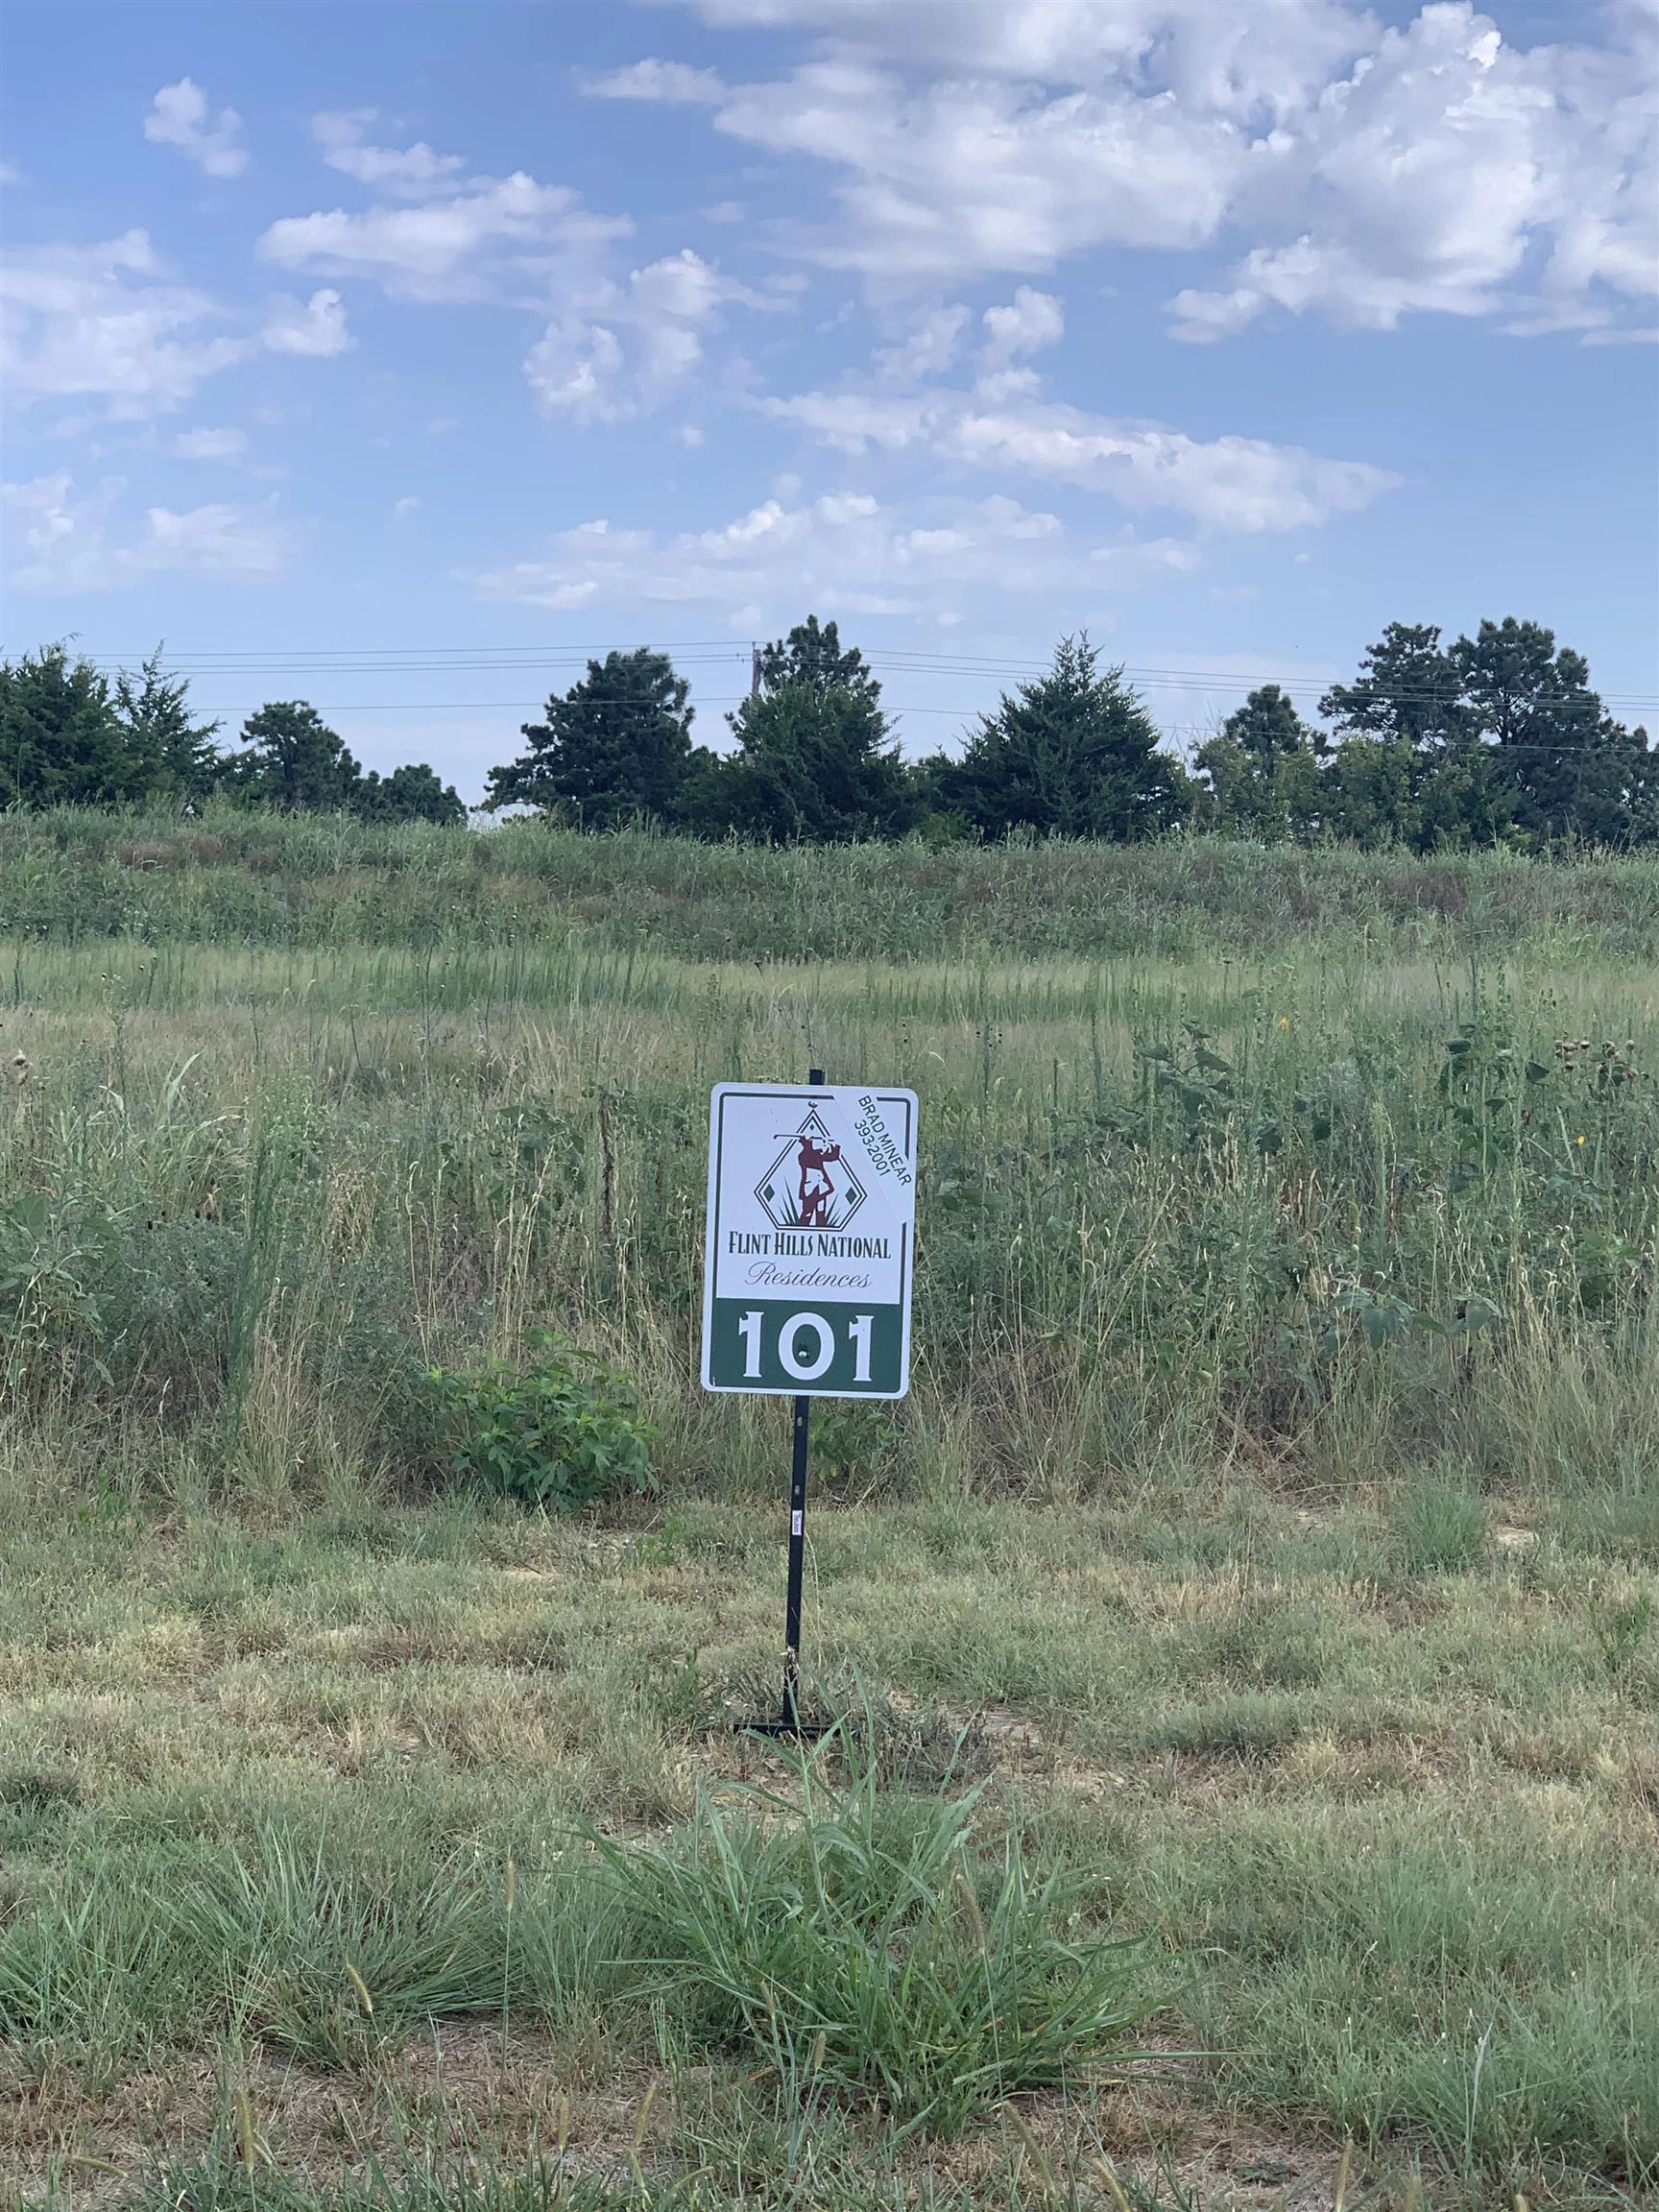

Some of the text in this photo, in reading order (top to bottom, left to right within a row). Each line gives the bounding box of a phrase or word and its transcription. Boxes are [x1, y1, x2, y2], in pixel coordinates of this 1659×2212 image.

[854, 1118, 891, 1176] 393-2001
[858, 1094, 912, 1187] BRAD MINEAR
[745, 1262, 872, 1288] Residences
[738, 1310, 875, 1382] 101
